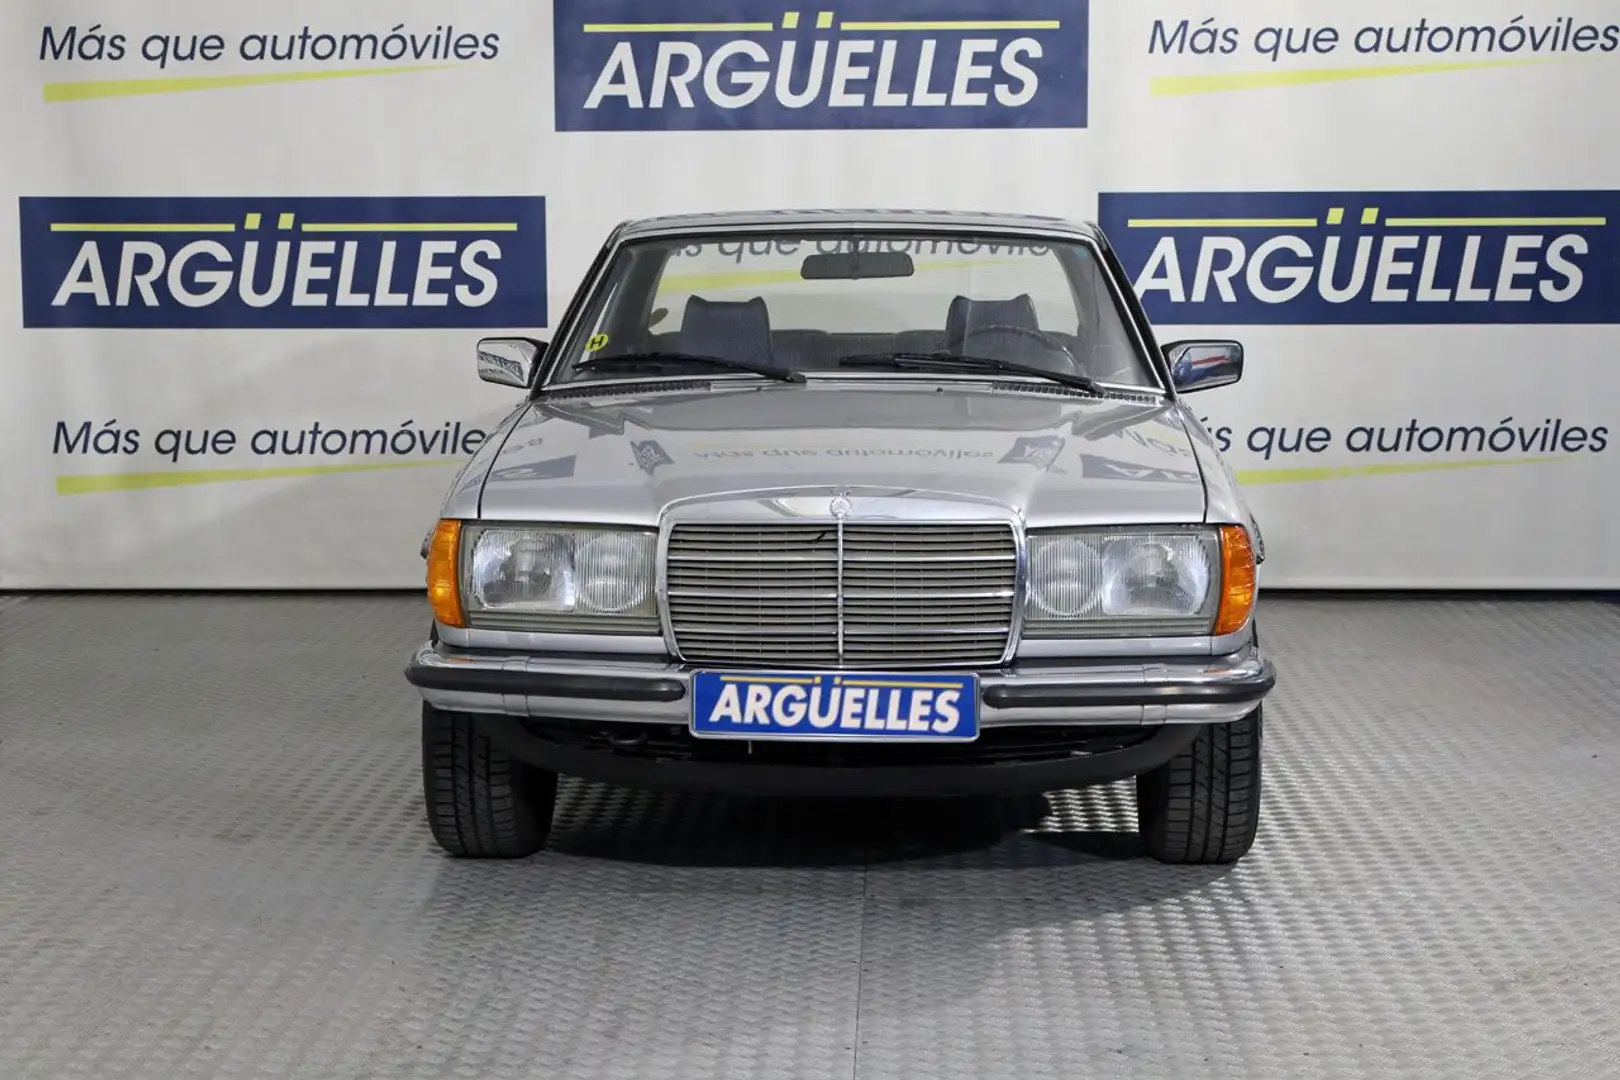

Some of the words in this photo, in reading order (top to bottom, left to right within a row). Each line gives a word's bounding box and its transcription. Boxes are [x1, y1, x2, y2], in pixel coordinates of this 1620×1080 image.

[40, 24, 125, 61] Más
[142, 35, 225, 69] que
[240, 24, 500, 61] automóviles
[584, 12, 1042, 109] ARGÜELLES
[1149, 17, 1238, 55] Más
[1254, 27, 1339, 62] que
[1354, 15, 1620, 53] automóviles
[52, 213, 502, 308] ARGÜELLES
[1133, 207, 1588, 304] ARGÜELLES
[53, 419, 139, 455] Más
[154, 429, 237, 463] que
[250, 419, 487, 456] automóvile
[1247, 426, 1332, 461] que
[1345, 416, 1609, 453] automóviles
[709, 676, 961, 734] ARGÜELLES
